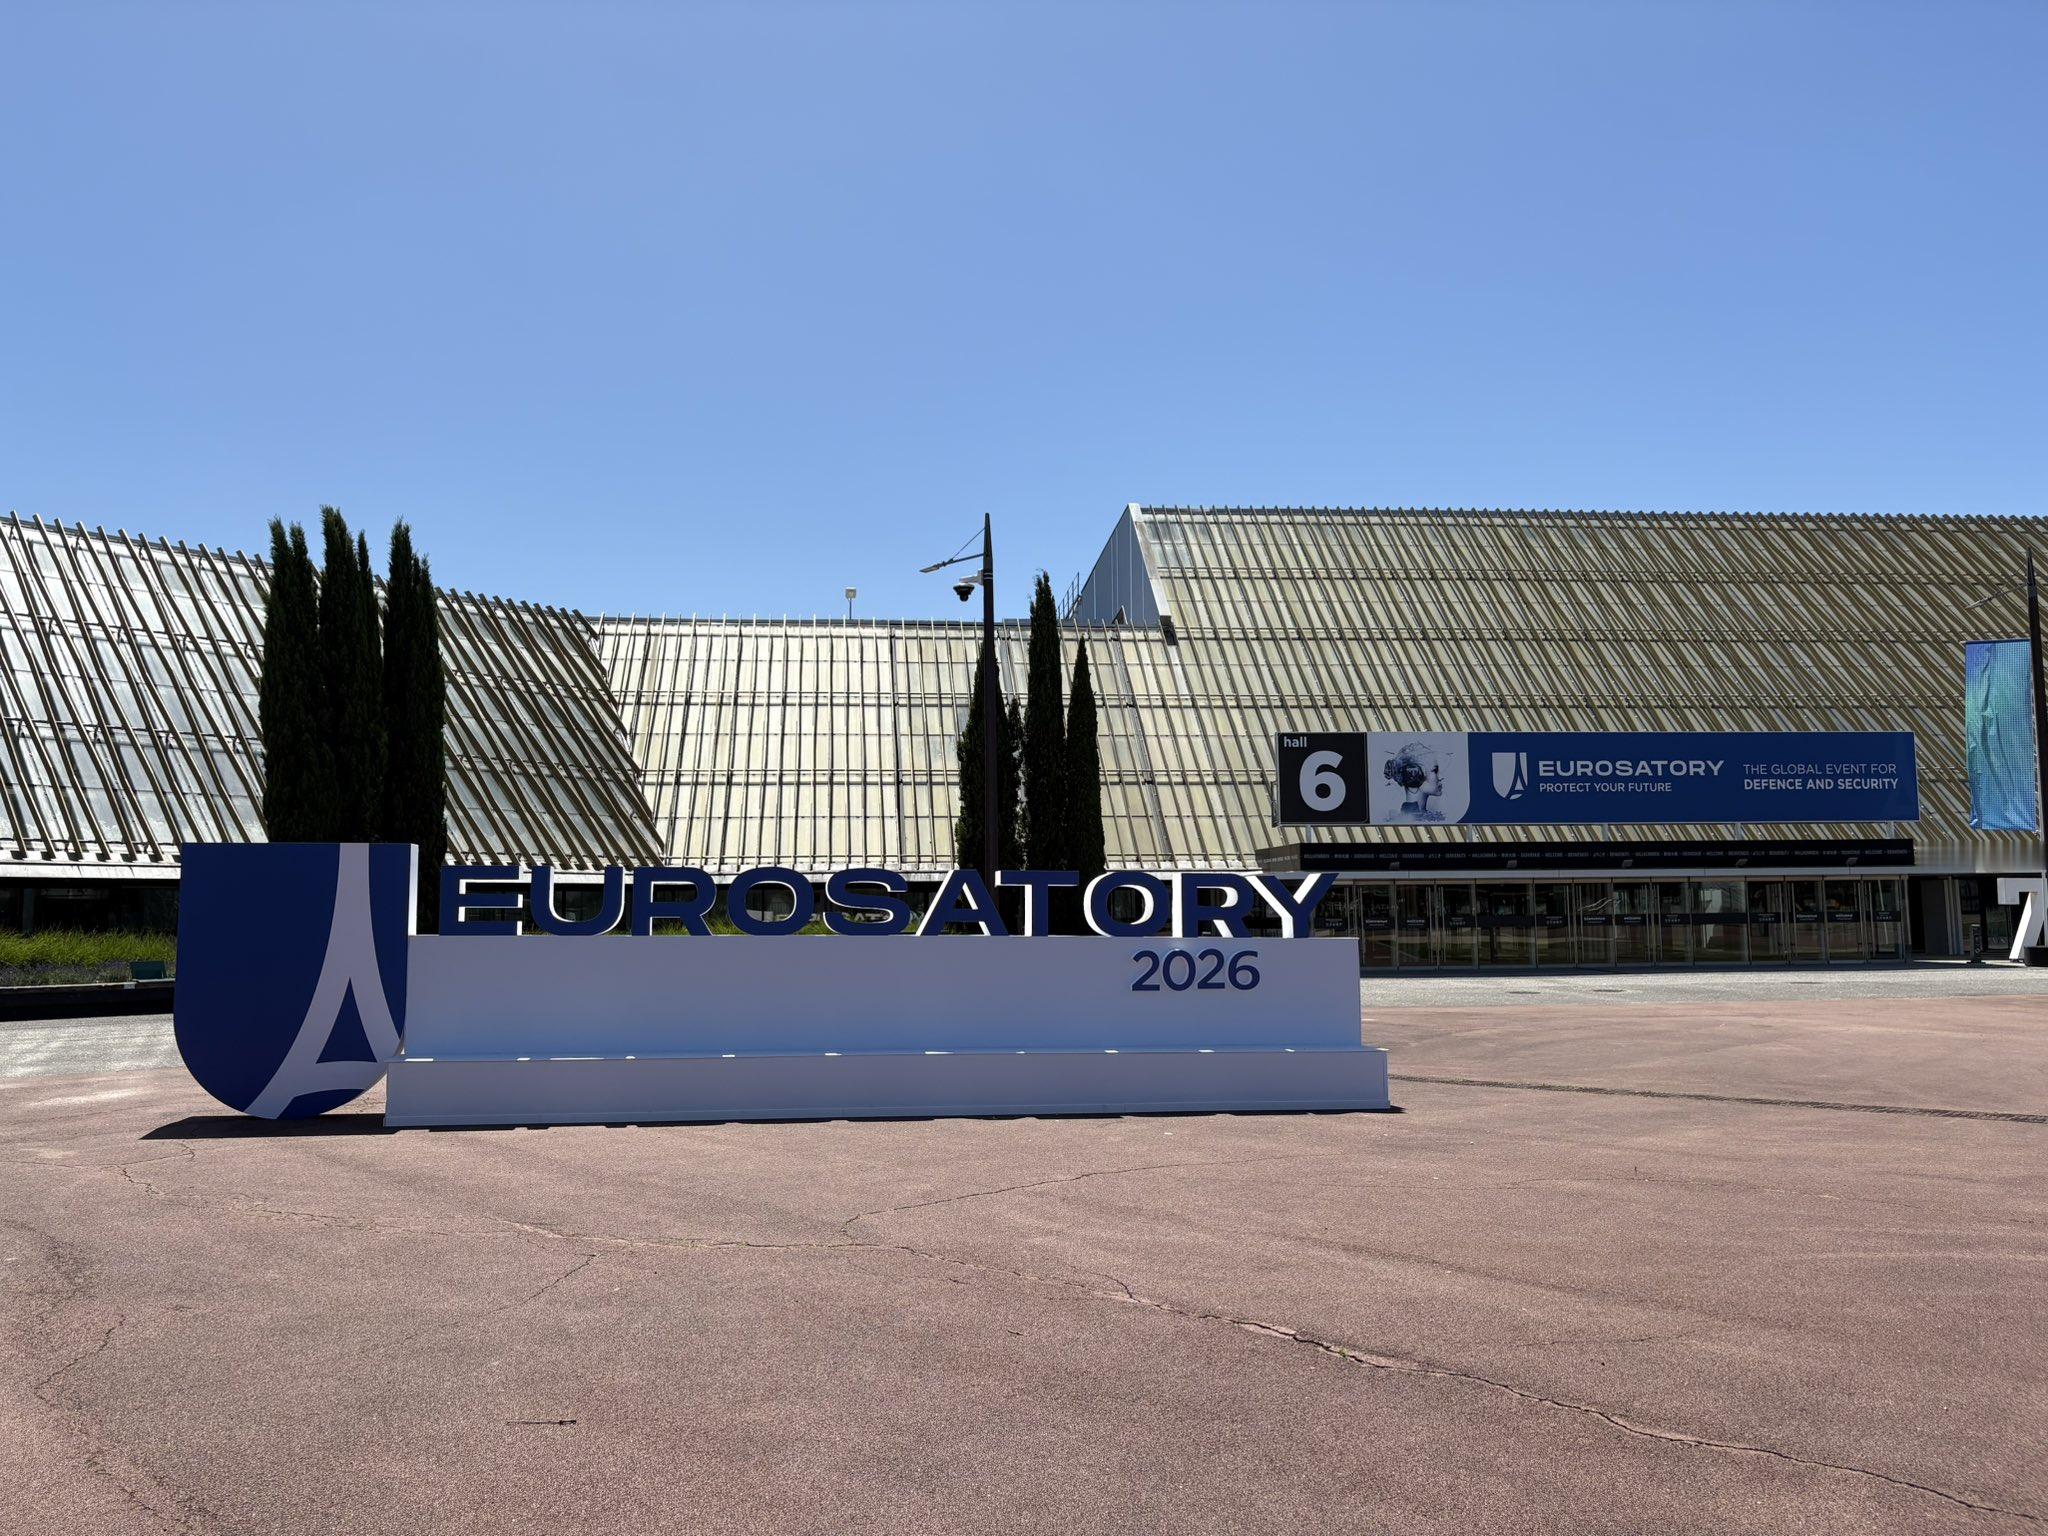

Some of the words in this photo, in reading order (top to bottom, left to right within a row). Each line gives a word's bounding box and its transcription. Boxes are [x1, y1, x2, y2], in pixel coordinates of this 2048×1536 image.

[1283, 736, 1308, 748] hall
[1538, 760, 1725, 777] EUROSATORY
[1743, 764, 1768, 775] THE
[1770, 764, 1822, 775] GLOBAL
[1826, 763, 1867, 774] EVENT
[1870, 763, 1897, 774] FOR
[1299, 750, 1347, 812] 6
[1539, 783, 1591, 793] PROTECT
[1593, 782, 1626, 792] YOUR
[1628, 782, 1673, 792] FUTURE
[1744, 779, 1803, 790] DEFENCE
[1806, 778, 1834, 790] AND
[1837, 778, 1899, 790] SECURITY
[438, 865, 1339, 938] EUROSATORY
[1131, 948, 1261, 992] 2026
